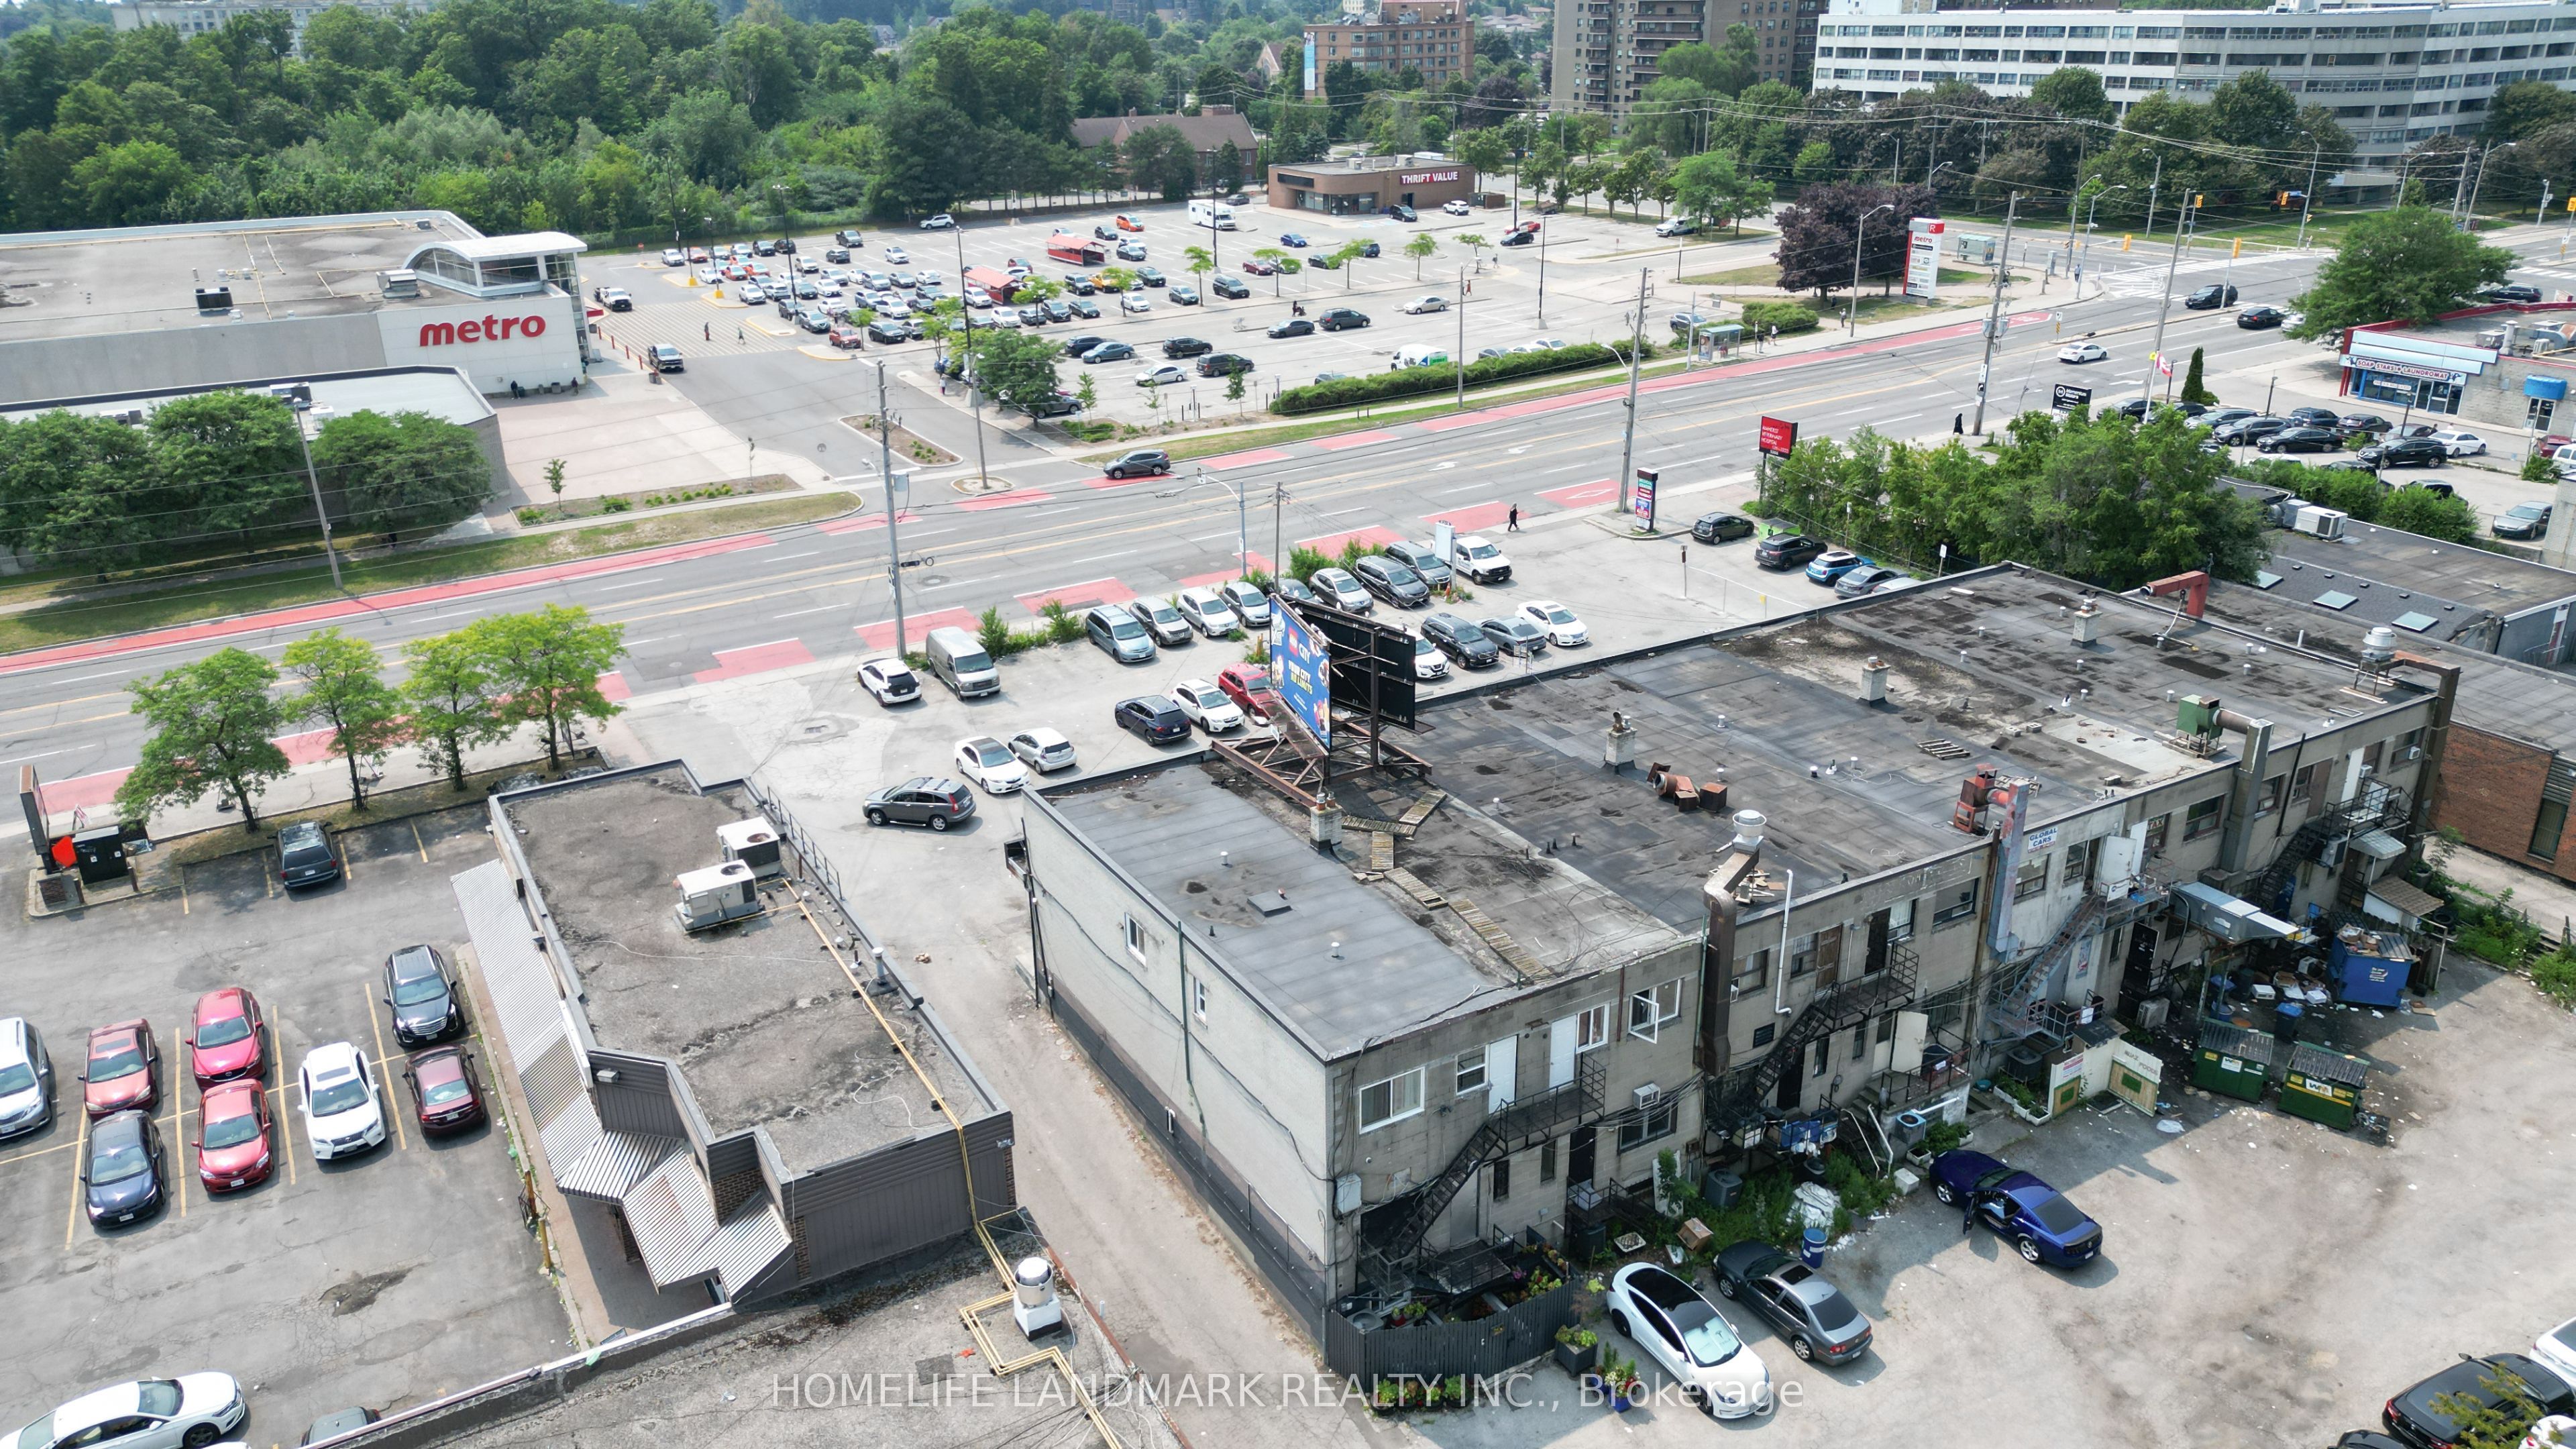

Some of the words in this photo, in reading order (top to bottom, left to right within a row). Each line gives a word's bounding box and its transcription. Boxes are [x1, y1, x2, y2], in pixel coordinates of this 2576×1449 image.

[1401, 174, 1430, 184] THRIFT
[1432, 171, 1458, 182] VALUE
[1929, 224, 1936, 232] R
[419, 314, 547, 347] metro
[2357, 360, 2375, 368] SOAP
[2403, 368, 2448, 380] LAUNDROMAT
[1299, 643, 1311, 664] CITY
[2030, 827, 2057, 841] GLOBAL
[2033, 836, 2052, 847] CARS
